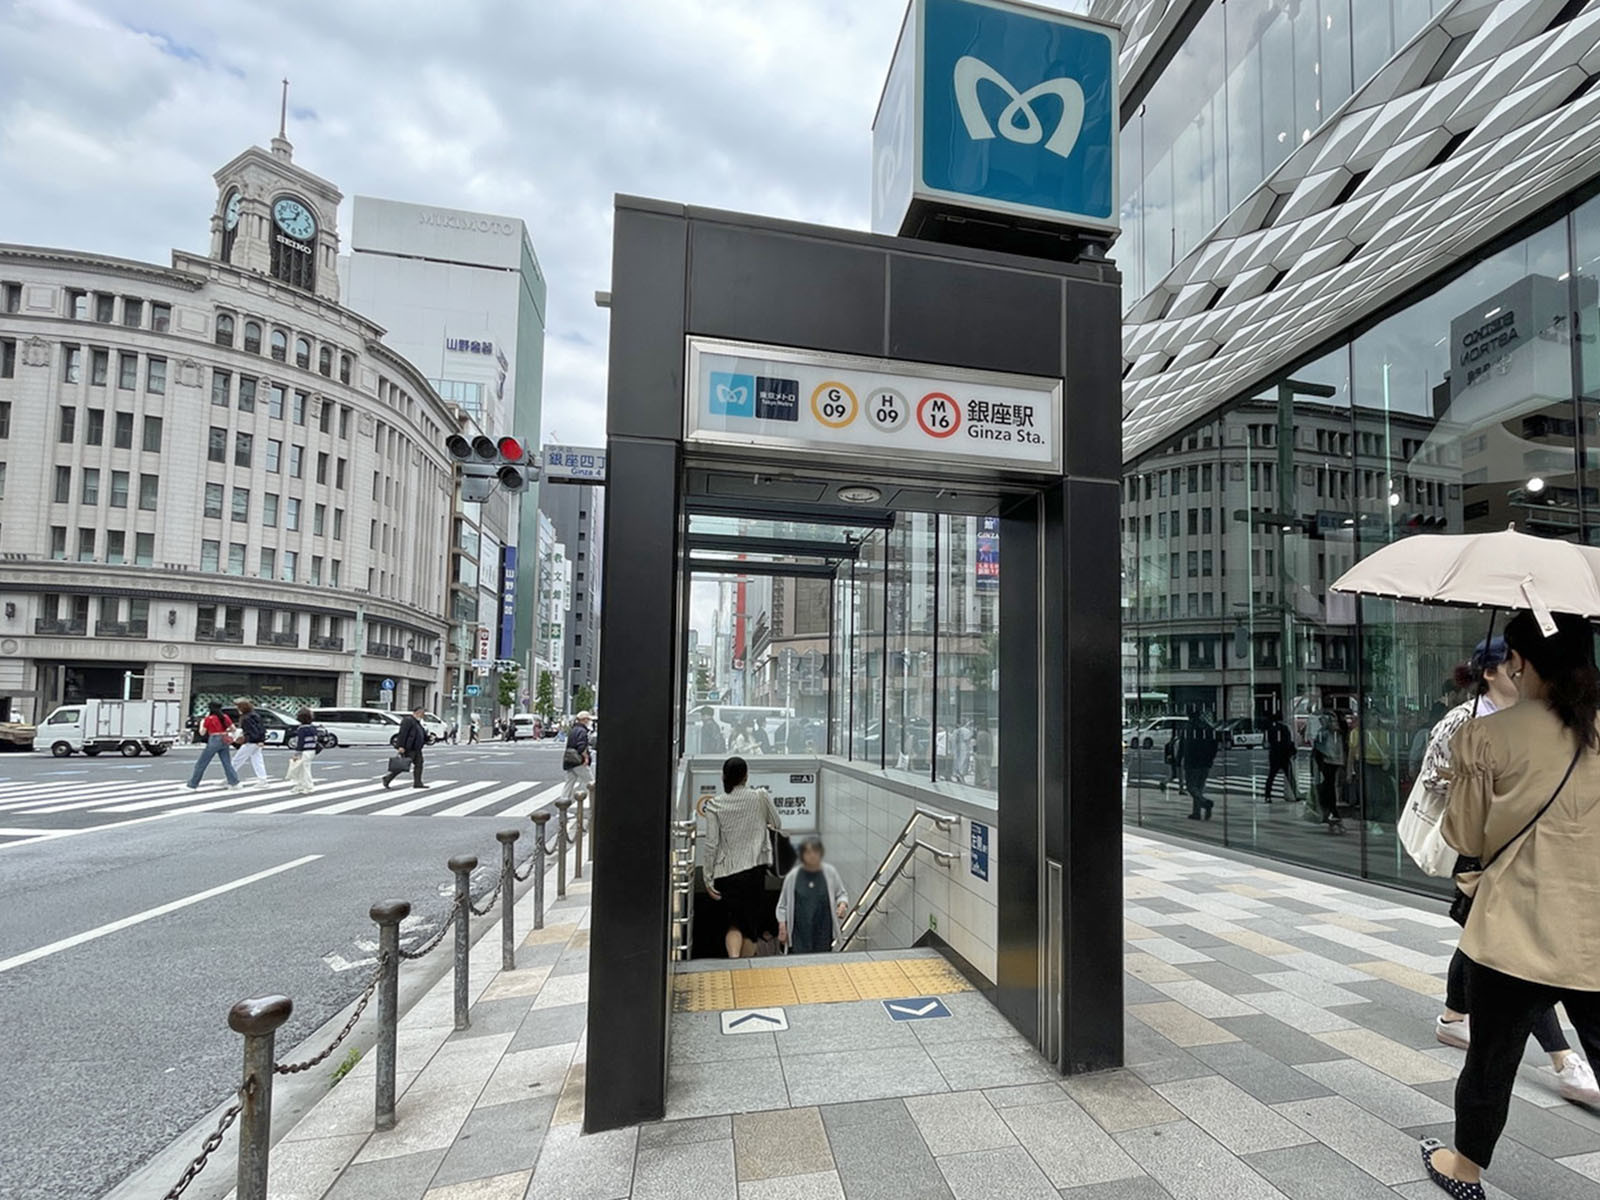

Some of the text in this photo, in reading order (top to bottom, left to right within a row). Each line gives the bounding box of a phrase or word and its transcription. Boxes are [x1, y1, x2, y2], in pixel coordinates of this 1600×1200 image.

[418, 210, 515, 236] MIKIMOTO
[276, 234, 312, 254] SEIKO
[828, 389, 841, 402] G
[882, 394, 894, 408] H
[823, 403, 846, 418] 09
[932, 401, 946, 414] M
[967, 400, 1034, 428] 銀座駅
[876, 408, 899, 423] 09
[931, 414, 950, 429] 16
[967, 425, 1046, 445] Ginza Sta.
[778, 808, 795, 816] inza
